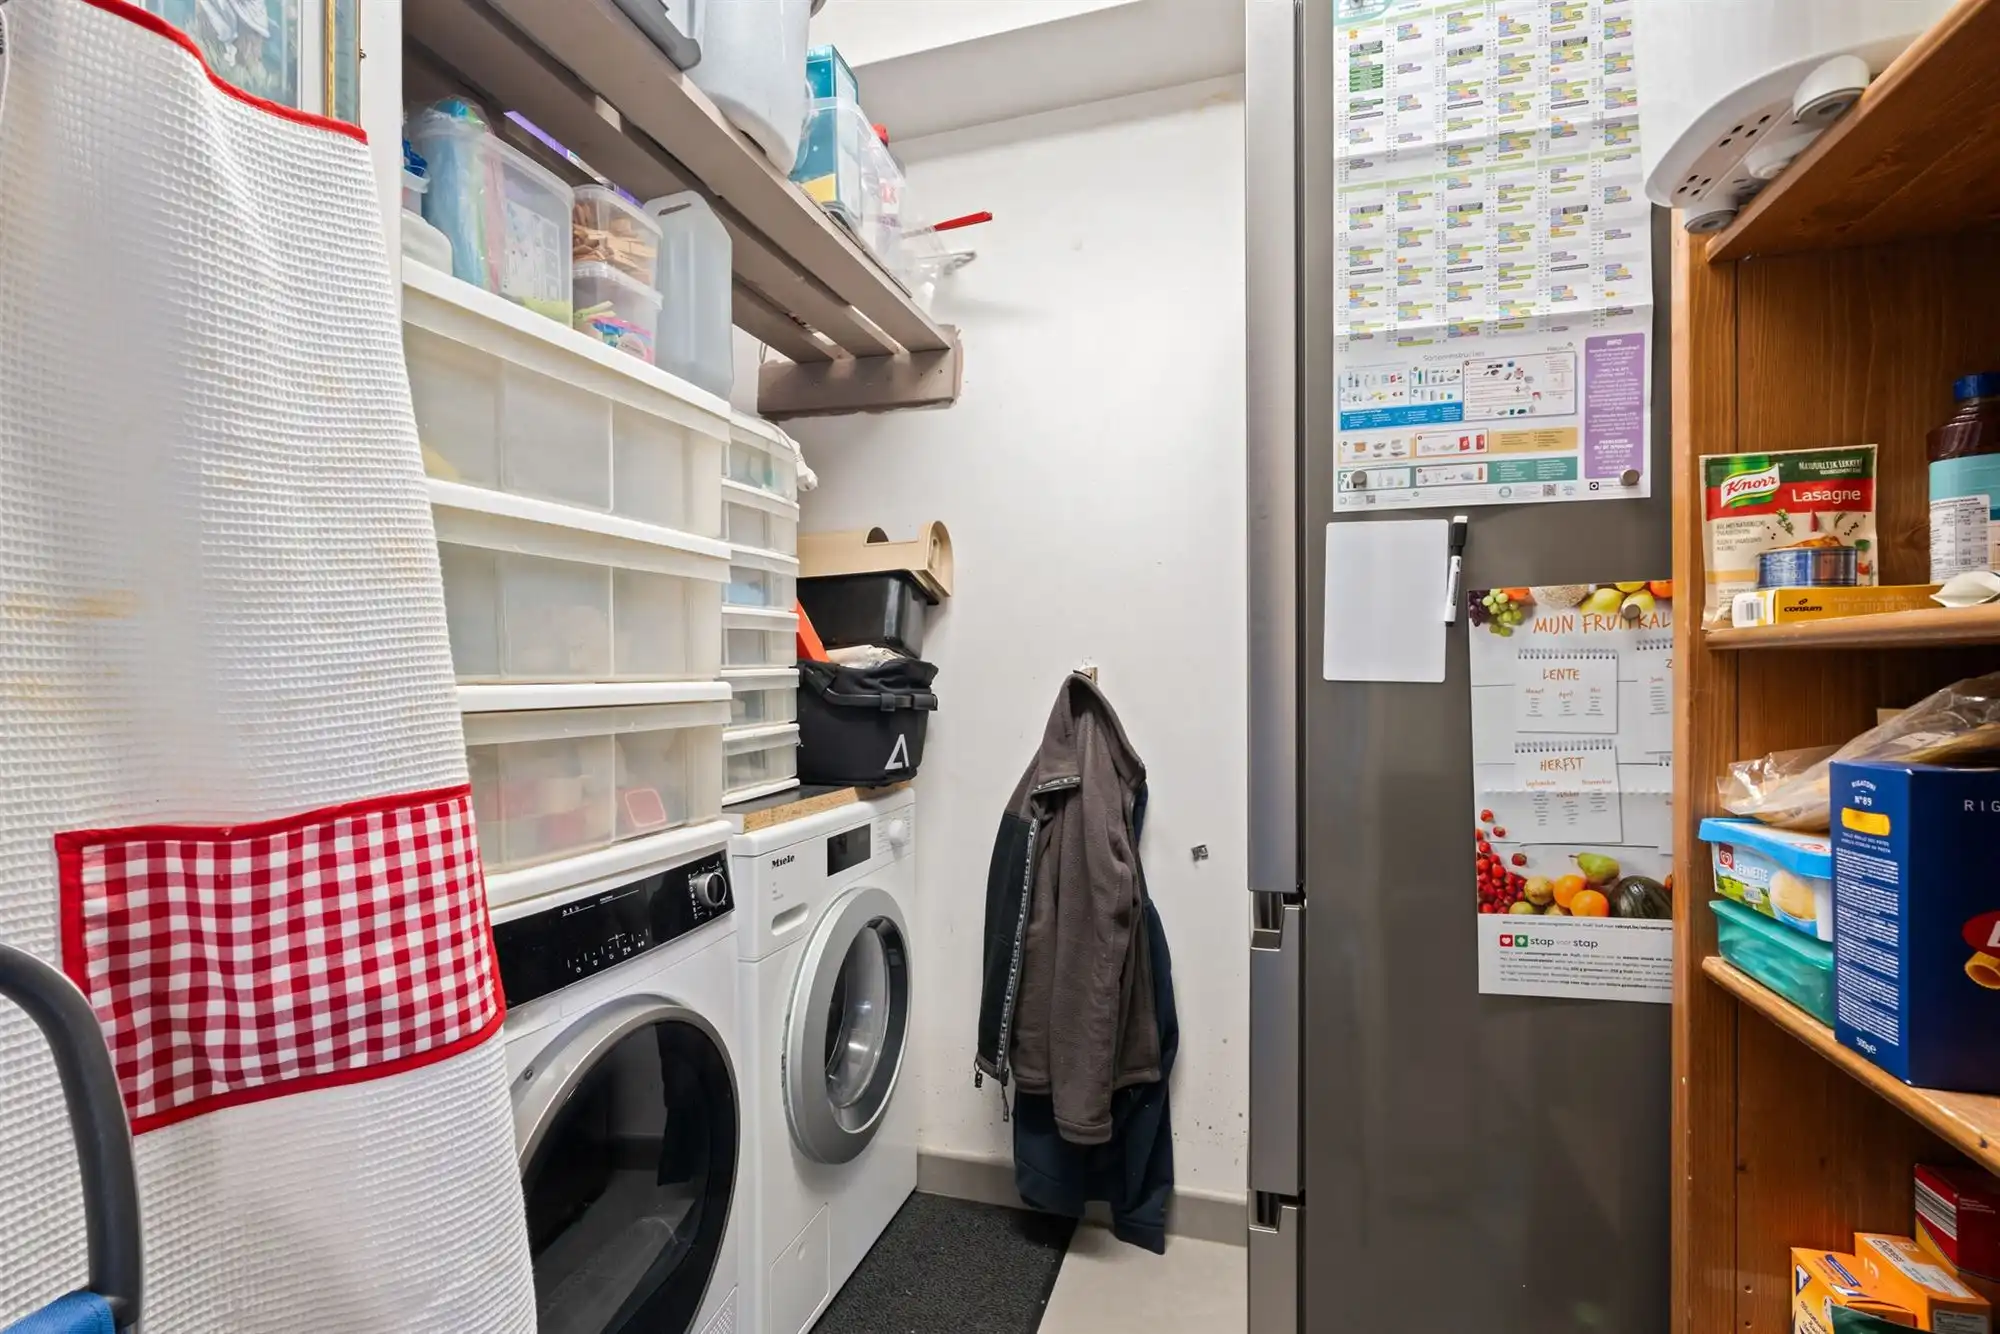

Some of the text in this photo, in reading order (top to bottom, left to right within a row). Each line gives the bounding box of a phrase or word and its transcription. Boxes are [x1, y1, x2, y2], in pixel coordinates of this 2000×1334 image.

[1726, 475, 1777, 496] Knorr
[1792, 489, 1861, 504] Lasagne
[1784, 605, 1823, 613] consum
[1533, 614, 1574, 635] MIJN
[1542, 668, 1580, 681] LENTE
[1540, 756, 1585, 772] HERFST
[1964, 799, 2000, 813] RIG
[772, 855, 795, 867] Miele
[1530, 937, 1555, 948] stap
[1573, 939, 1598, 949] stap
